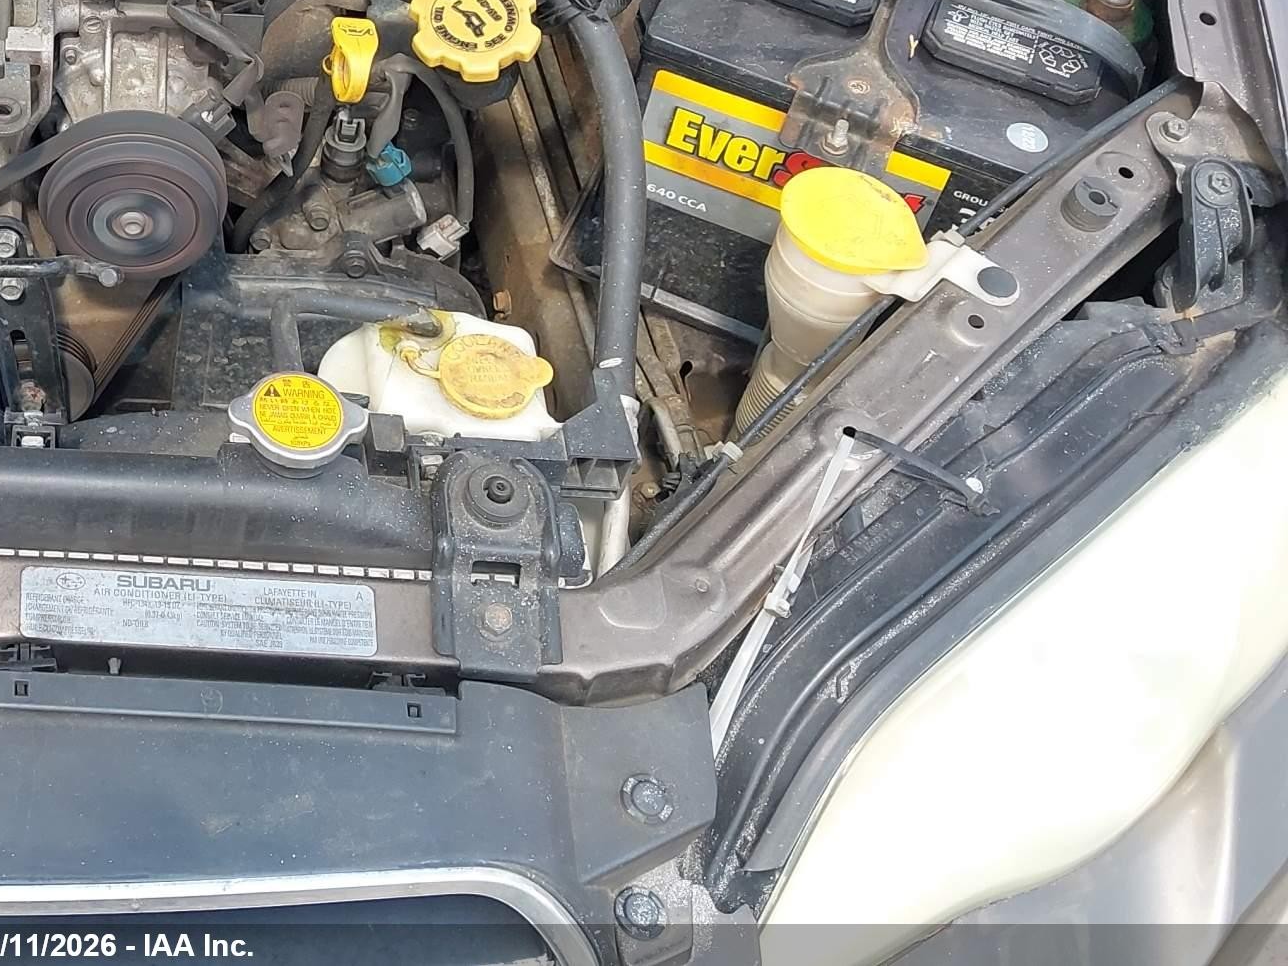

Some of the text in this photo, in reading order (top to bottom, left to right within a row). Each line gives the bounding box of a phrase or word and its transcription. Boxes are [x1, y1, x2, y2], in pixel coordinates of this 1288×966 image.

[433, 6, 478, 52] ENGINE OIL
[484, 33, 508, 48] SEE
[646, 184, 708, 213] 640 CCA
[282, 388, 325, 399] WARNING
[116, 574, 211, 592] SUBARU
[94, 587, 111, 597] AIR
[113, 587, 181, 601] CONDITIONER
[263, 586, 306, 598] LAFAYETTE
[355, 591, 364, 602] A
[254, 596, 312, 608] CLIMATISEUR
